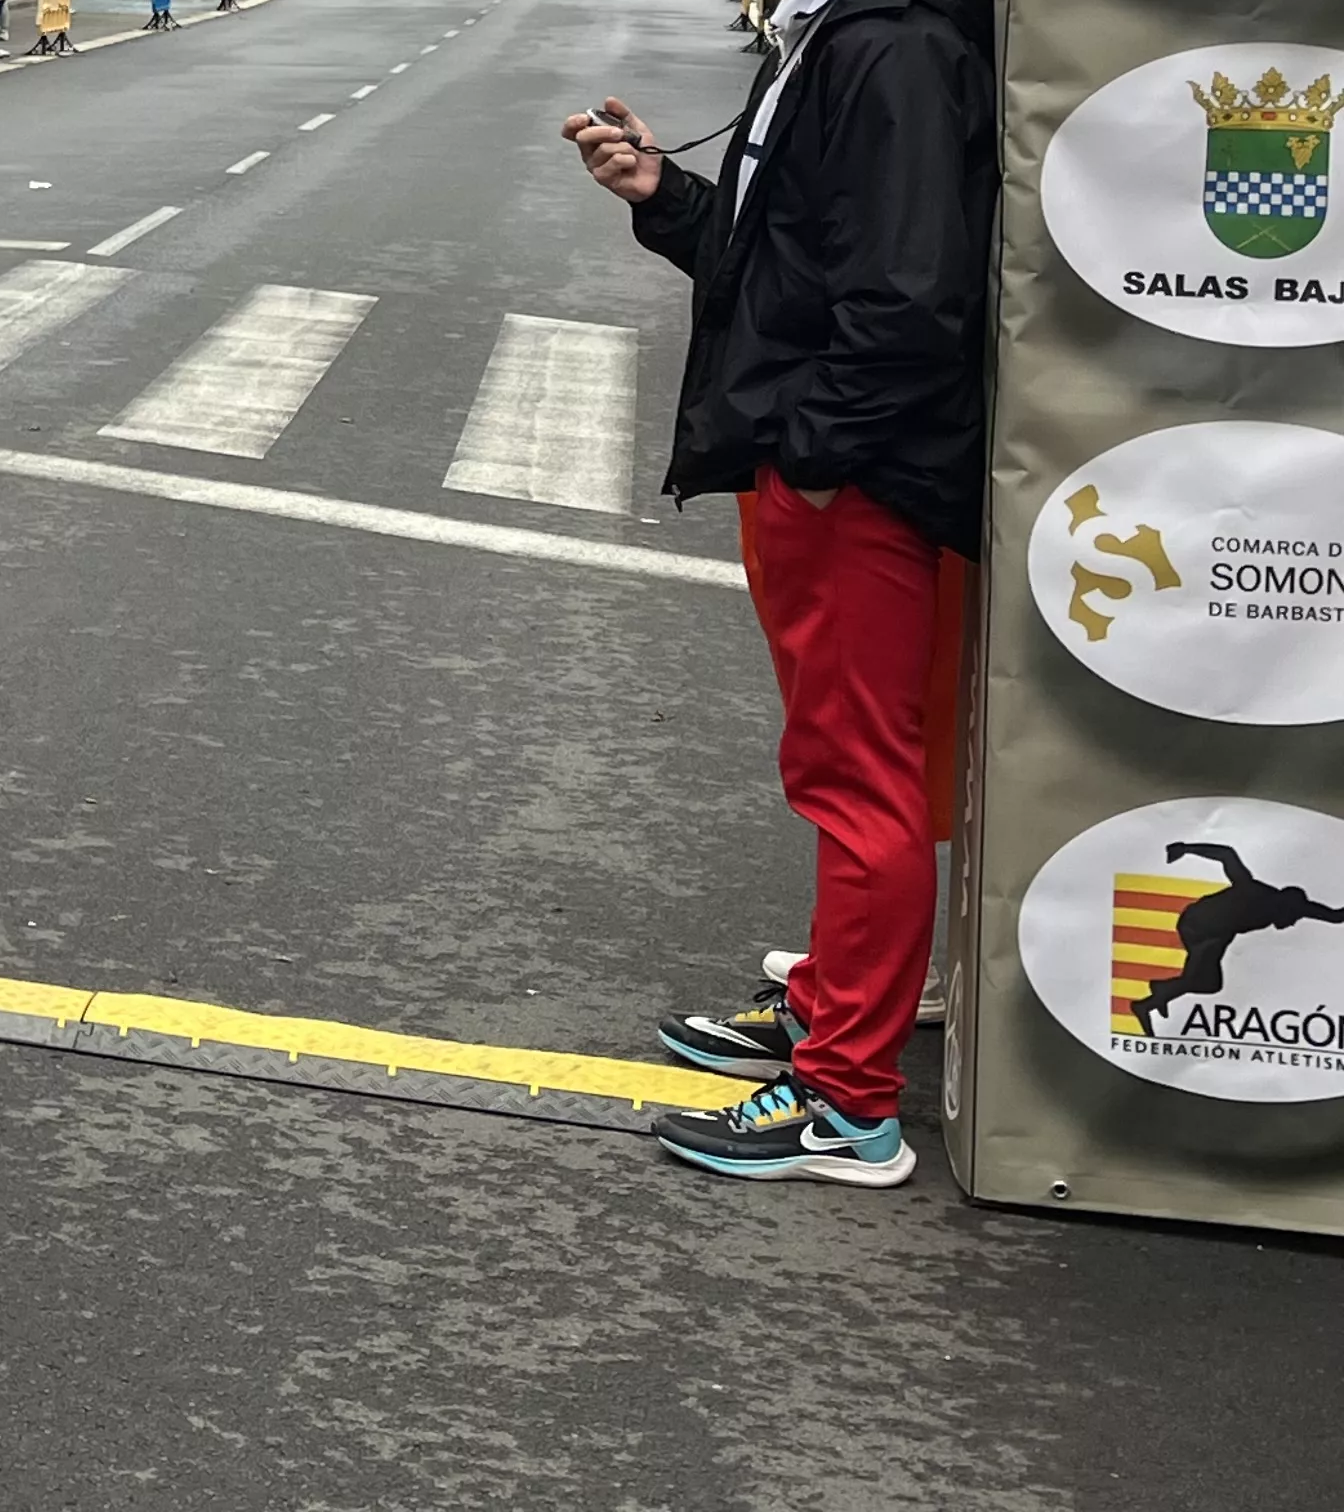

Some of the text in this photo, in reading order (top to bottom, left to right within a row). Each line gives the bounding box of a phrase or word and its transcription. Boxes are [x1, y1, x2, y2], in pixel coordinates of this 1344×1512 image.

[1123, 271, 1344, 305] SALAS BAJ
[1211, 536, 1320, 557] COMARCA
[1210, 562, 1344, 595] SOMON
[1208, 601, 1344, 622] DE BARBAST
[1180, 1003, 1344, 1050] ARAGÓ
[1110, 1038, 1242, 1061] FEDERACIÓN
